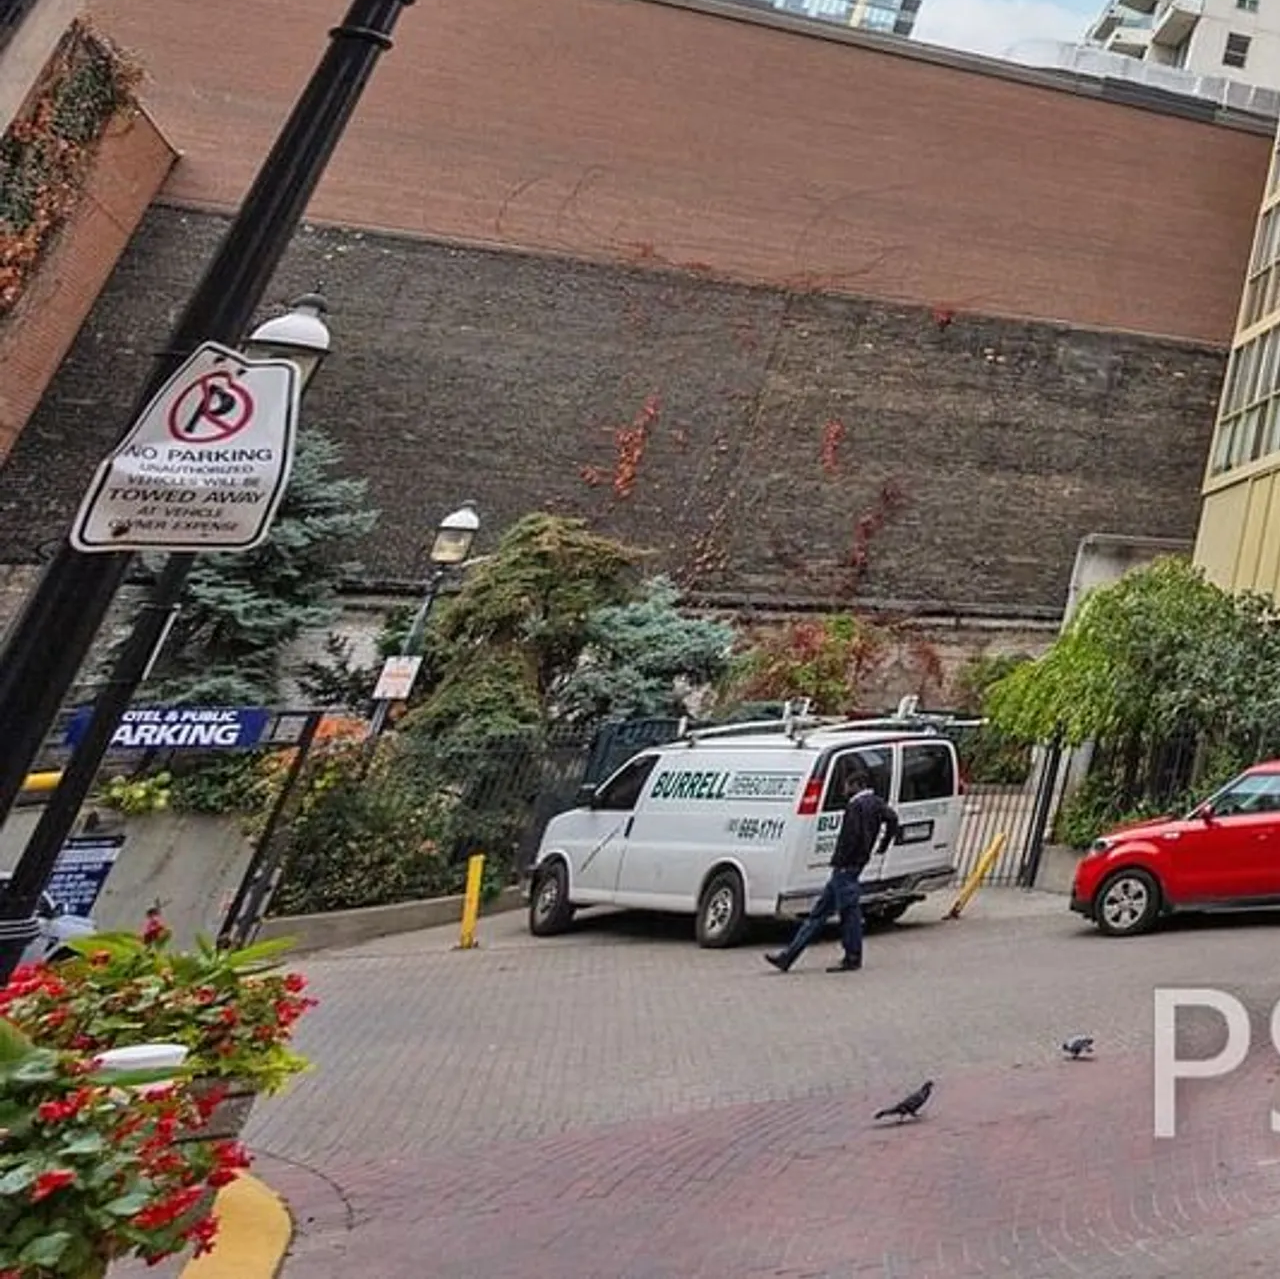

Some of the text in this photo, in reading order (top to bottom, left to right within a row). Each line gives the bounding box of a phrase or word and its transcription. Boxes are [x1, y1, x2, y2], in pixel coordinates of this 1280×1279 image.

[123, 445, 273, 463] NO PARKING
[139, 463, 254, 474] UNAUTHORIZED
[127, 475, 199, 487] VEHICLES
[203, 476, 236, 488] WILL
[108, 487, 268, 504] TOWED AWAY
[136, 505, 224, 518] AT VEHICLE
[171, 520, 241, 532] EXPENSE
[121, 710, 162, 722] OTEL
[179, 710, 239, 722] PUBLIC
[109, 723, 242, 746] ARKING
[650, 771, 731, 800] BURRELL
